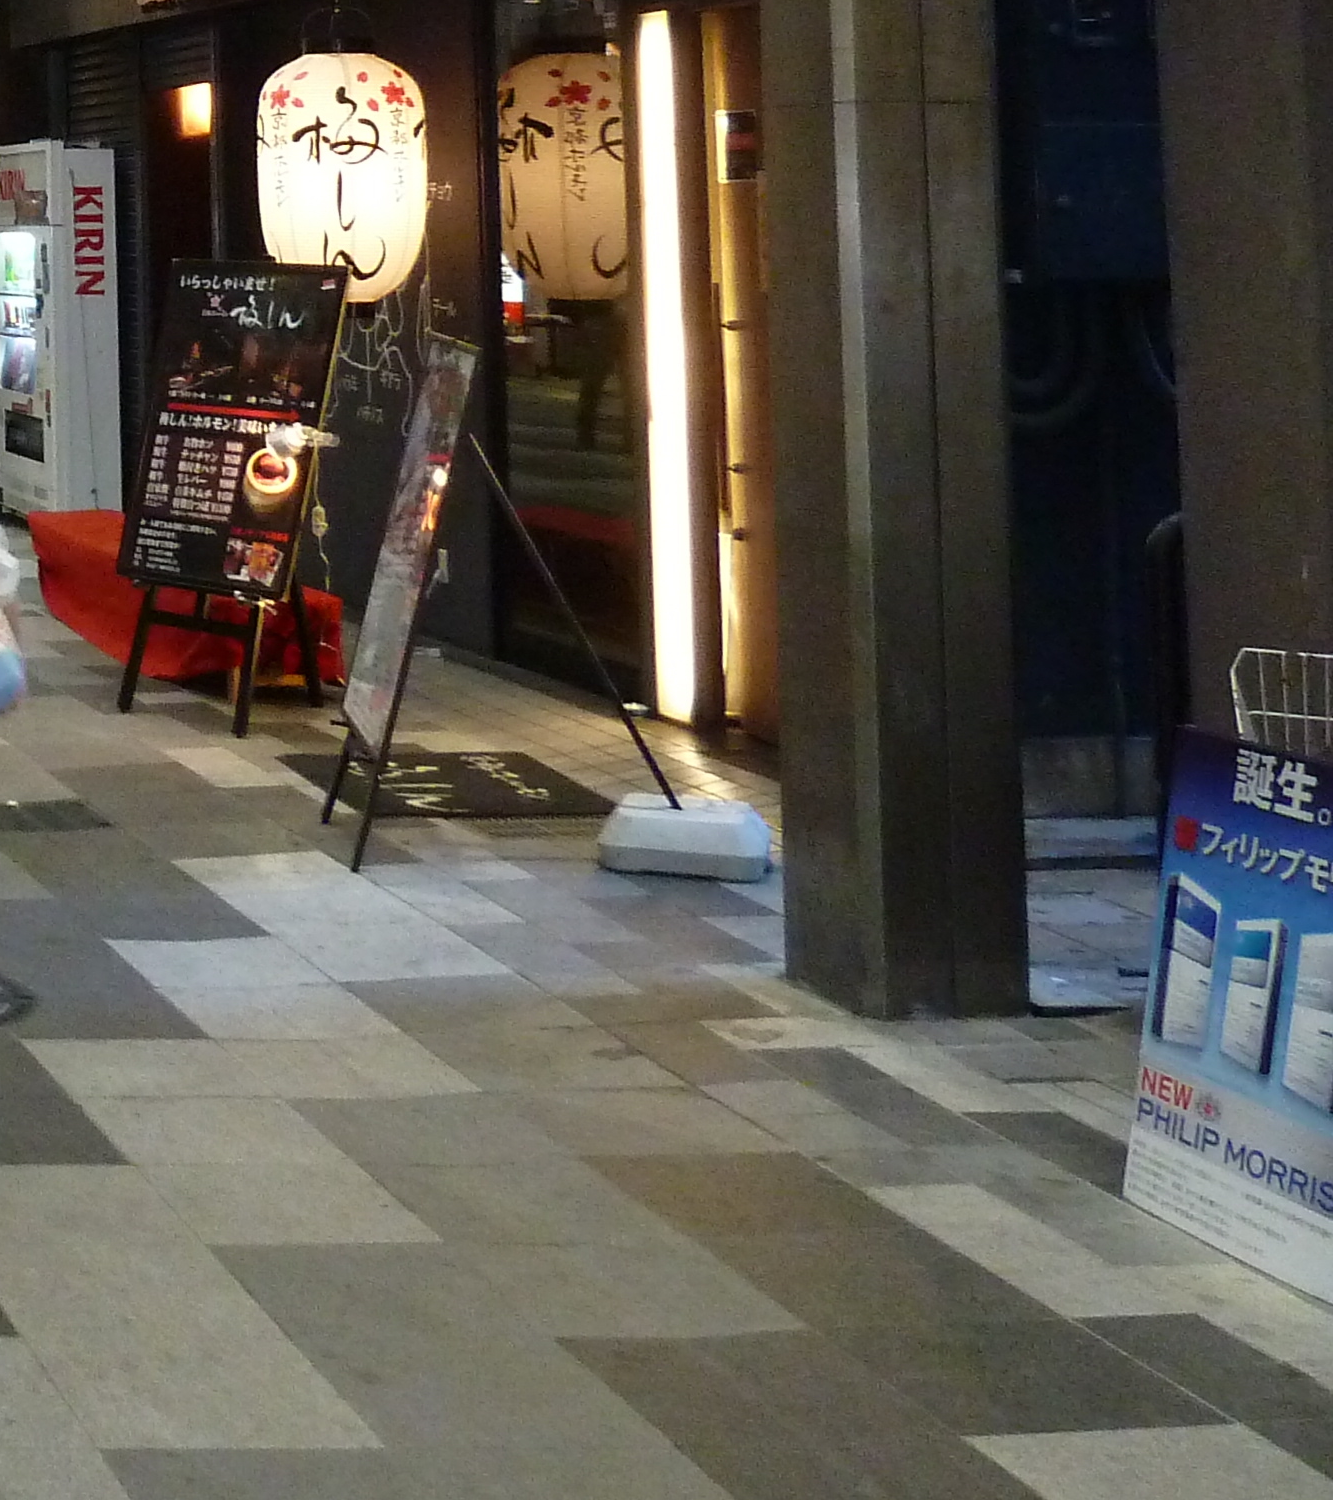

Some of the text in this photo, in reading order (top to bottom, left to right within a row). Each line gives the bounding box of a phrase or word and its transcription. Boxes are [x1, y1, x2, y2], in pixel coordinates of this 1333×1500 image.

[73, 185, 106, 297] KIRIN
[179, 274, 276, 292] いらっしゃいませ!
[1233, 748, 1332, 826] 誕生。
[1141, 1066, 1194, 1111] NEW
[1136, 1096, 1221, 1153] PHILIP
[1223, 1137, 1333, 1213] MORRIS
